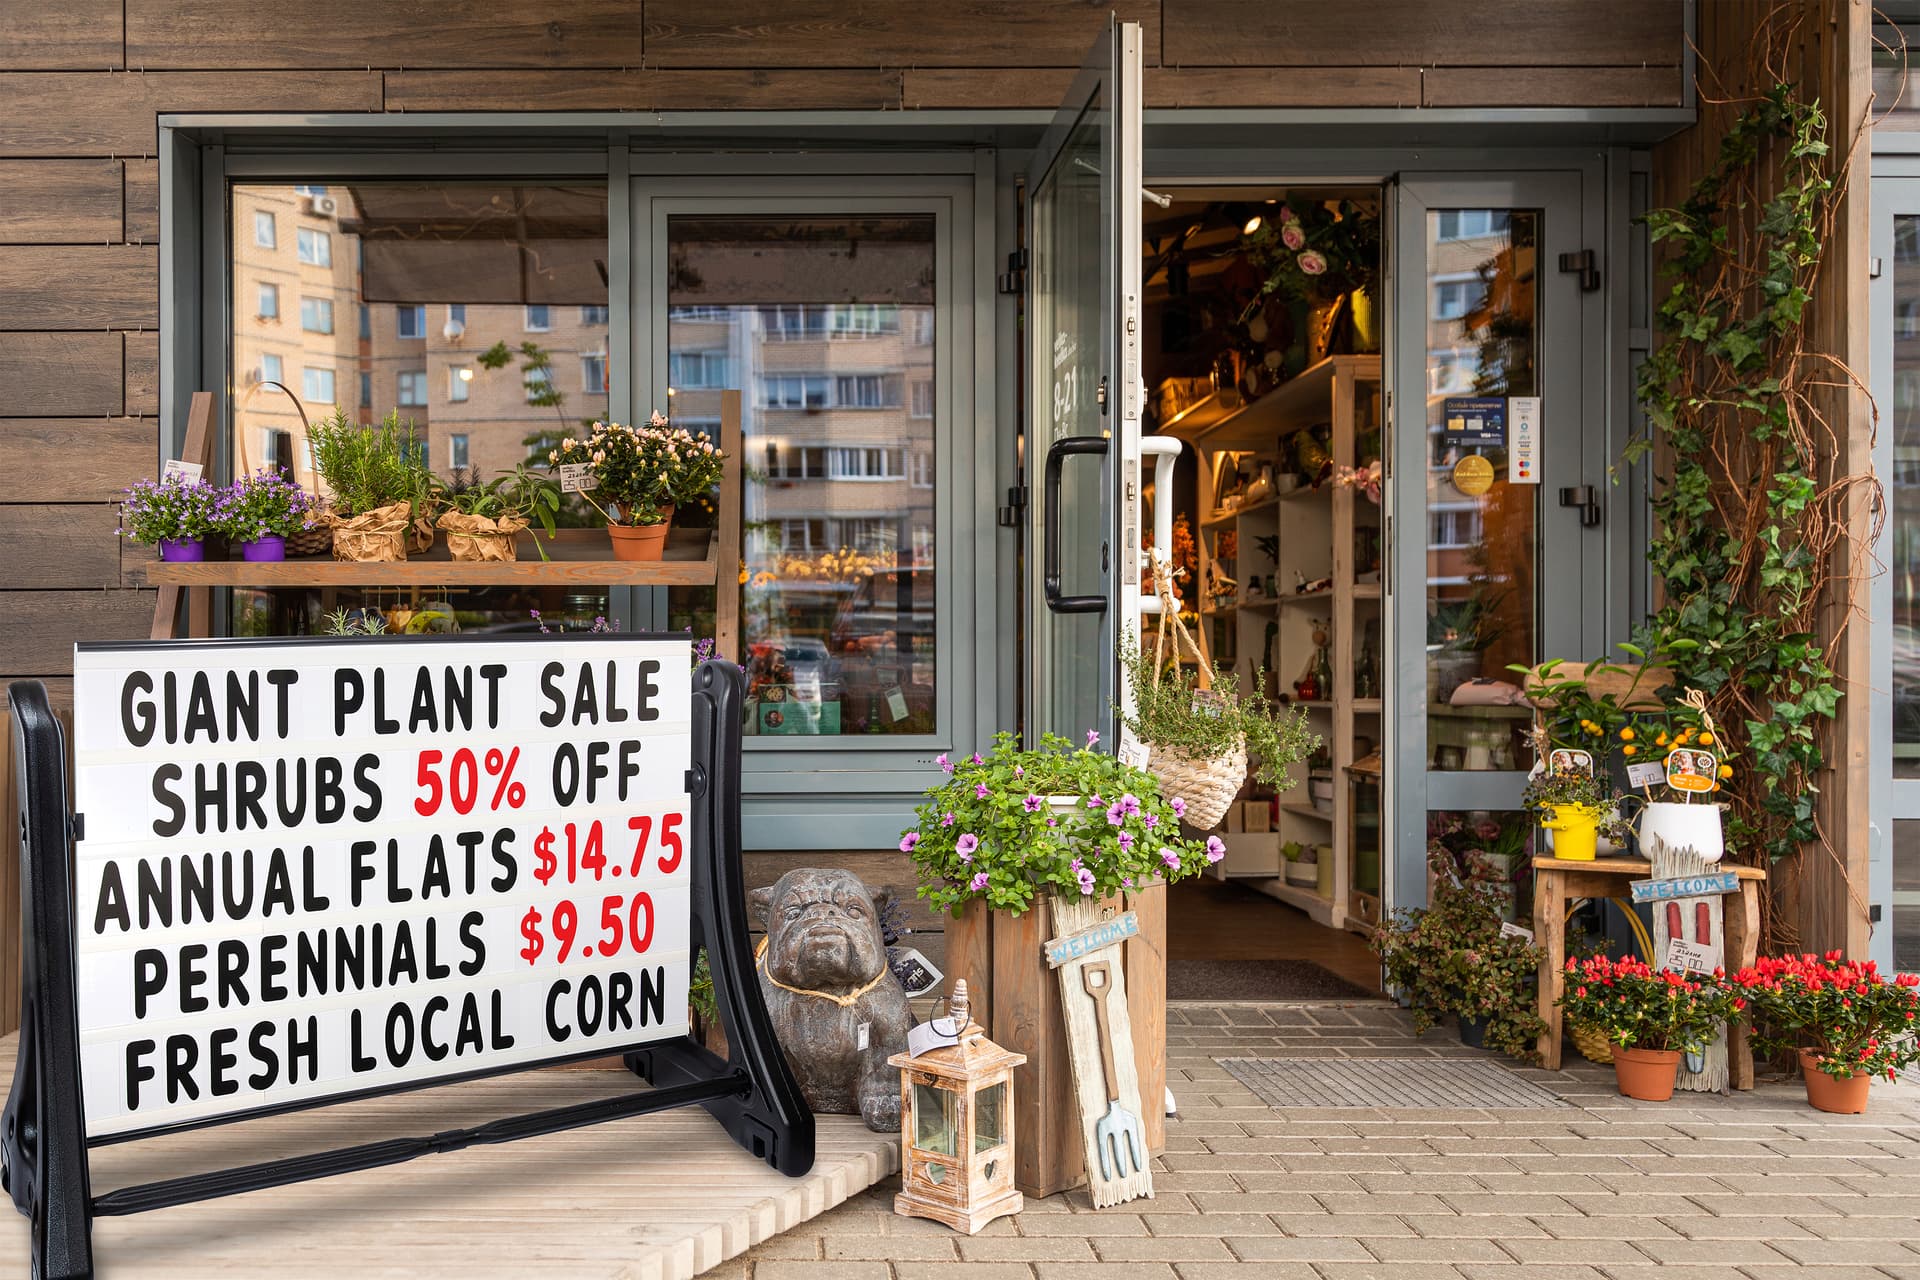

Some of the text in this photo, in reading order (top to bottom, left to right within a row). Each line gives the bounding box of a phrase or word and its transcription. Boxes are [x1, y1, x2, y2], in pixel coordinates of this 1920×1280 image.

[1054, 365, 1077, 422] 8-21
[121, 660, 660, 747] GIANT PLANT SALE
[152, 740, 642, 838] SHRUBS 50% OFF
[94, 812, 683, 935] ANNUAL FLATS $14.75
[1635, 873, 1737, 898] WELCOME
[134, 891, 655, 1020] PERENNIALS $9.50
[1050, 914, 1138, 962] WELCOME
[126, 966, 665, 1111] FRESH LOCAL CORN
